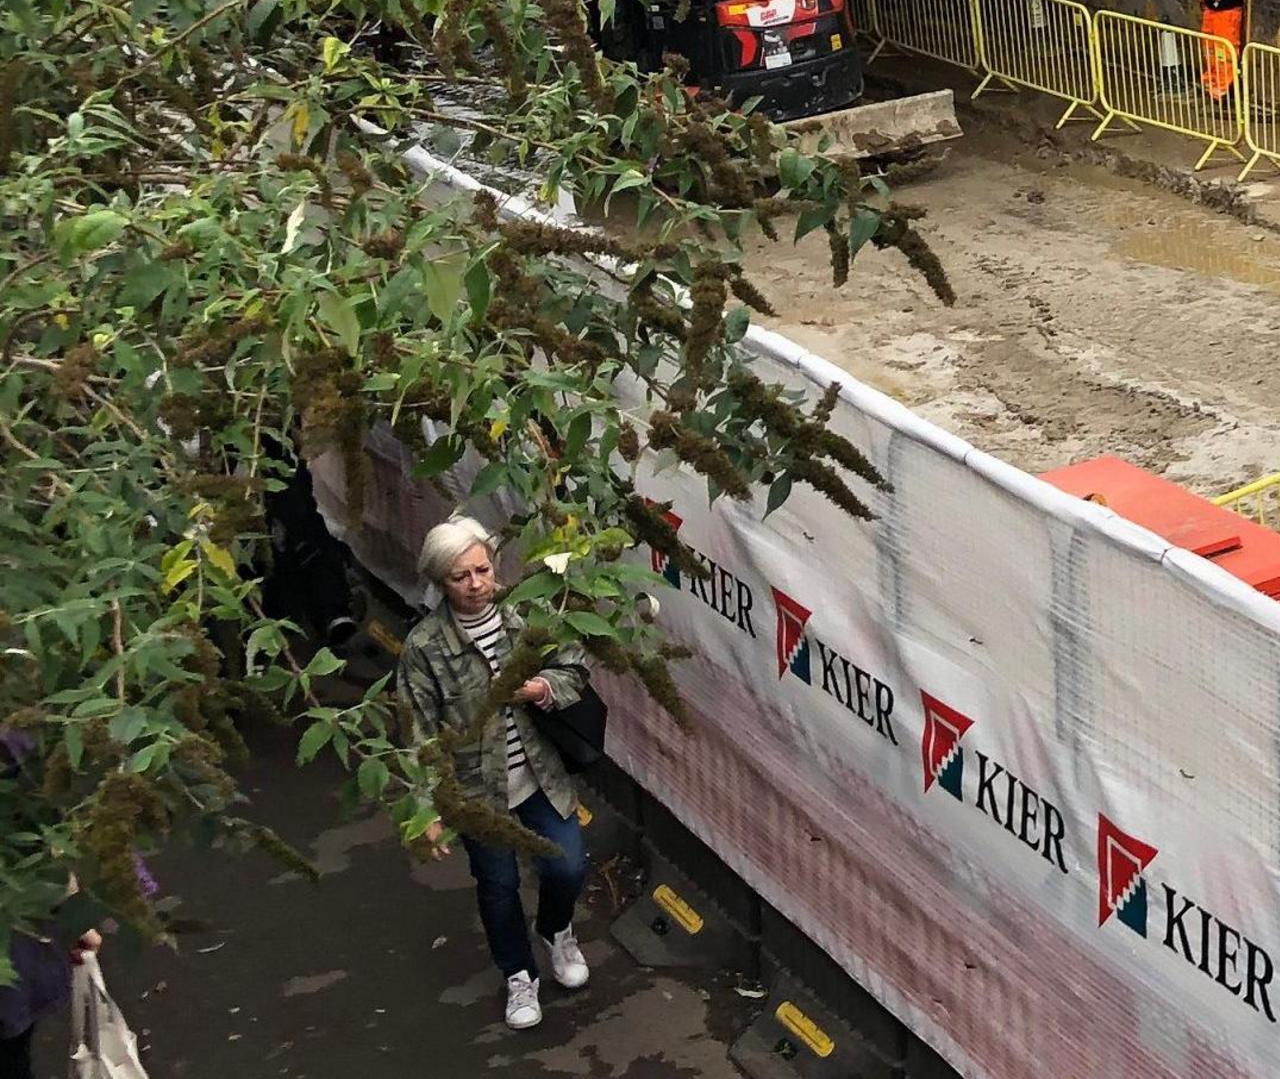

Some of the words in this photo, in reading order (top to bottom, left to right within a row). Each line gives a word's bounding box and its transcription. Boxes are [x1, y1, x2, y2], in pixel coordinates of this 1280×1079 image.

[687, 545, 757, 638] KIER
[816, 637, 899, 746] KIER
[974, 749, 1069, 874] KIER
[1161, 881, 1277, 1023] KIER
